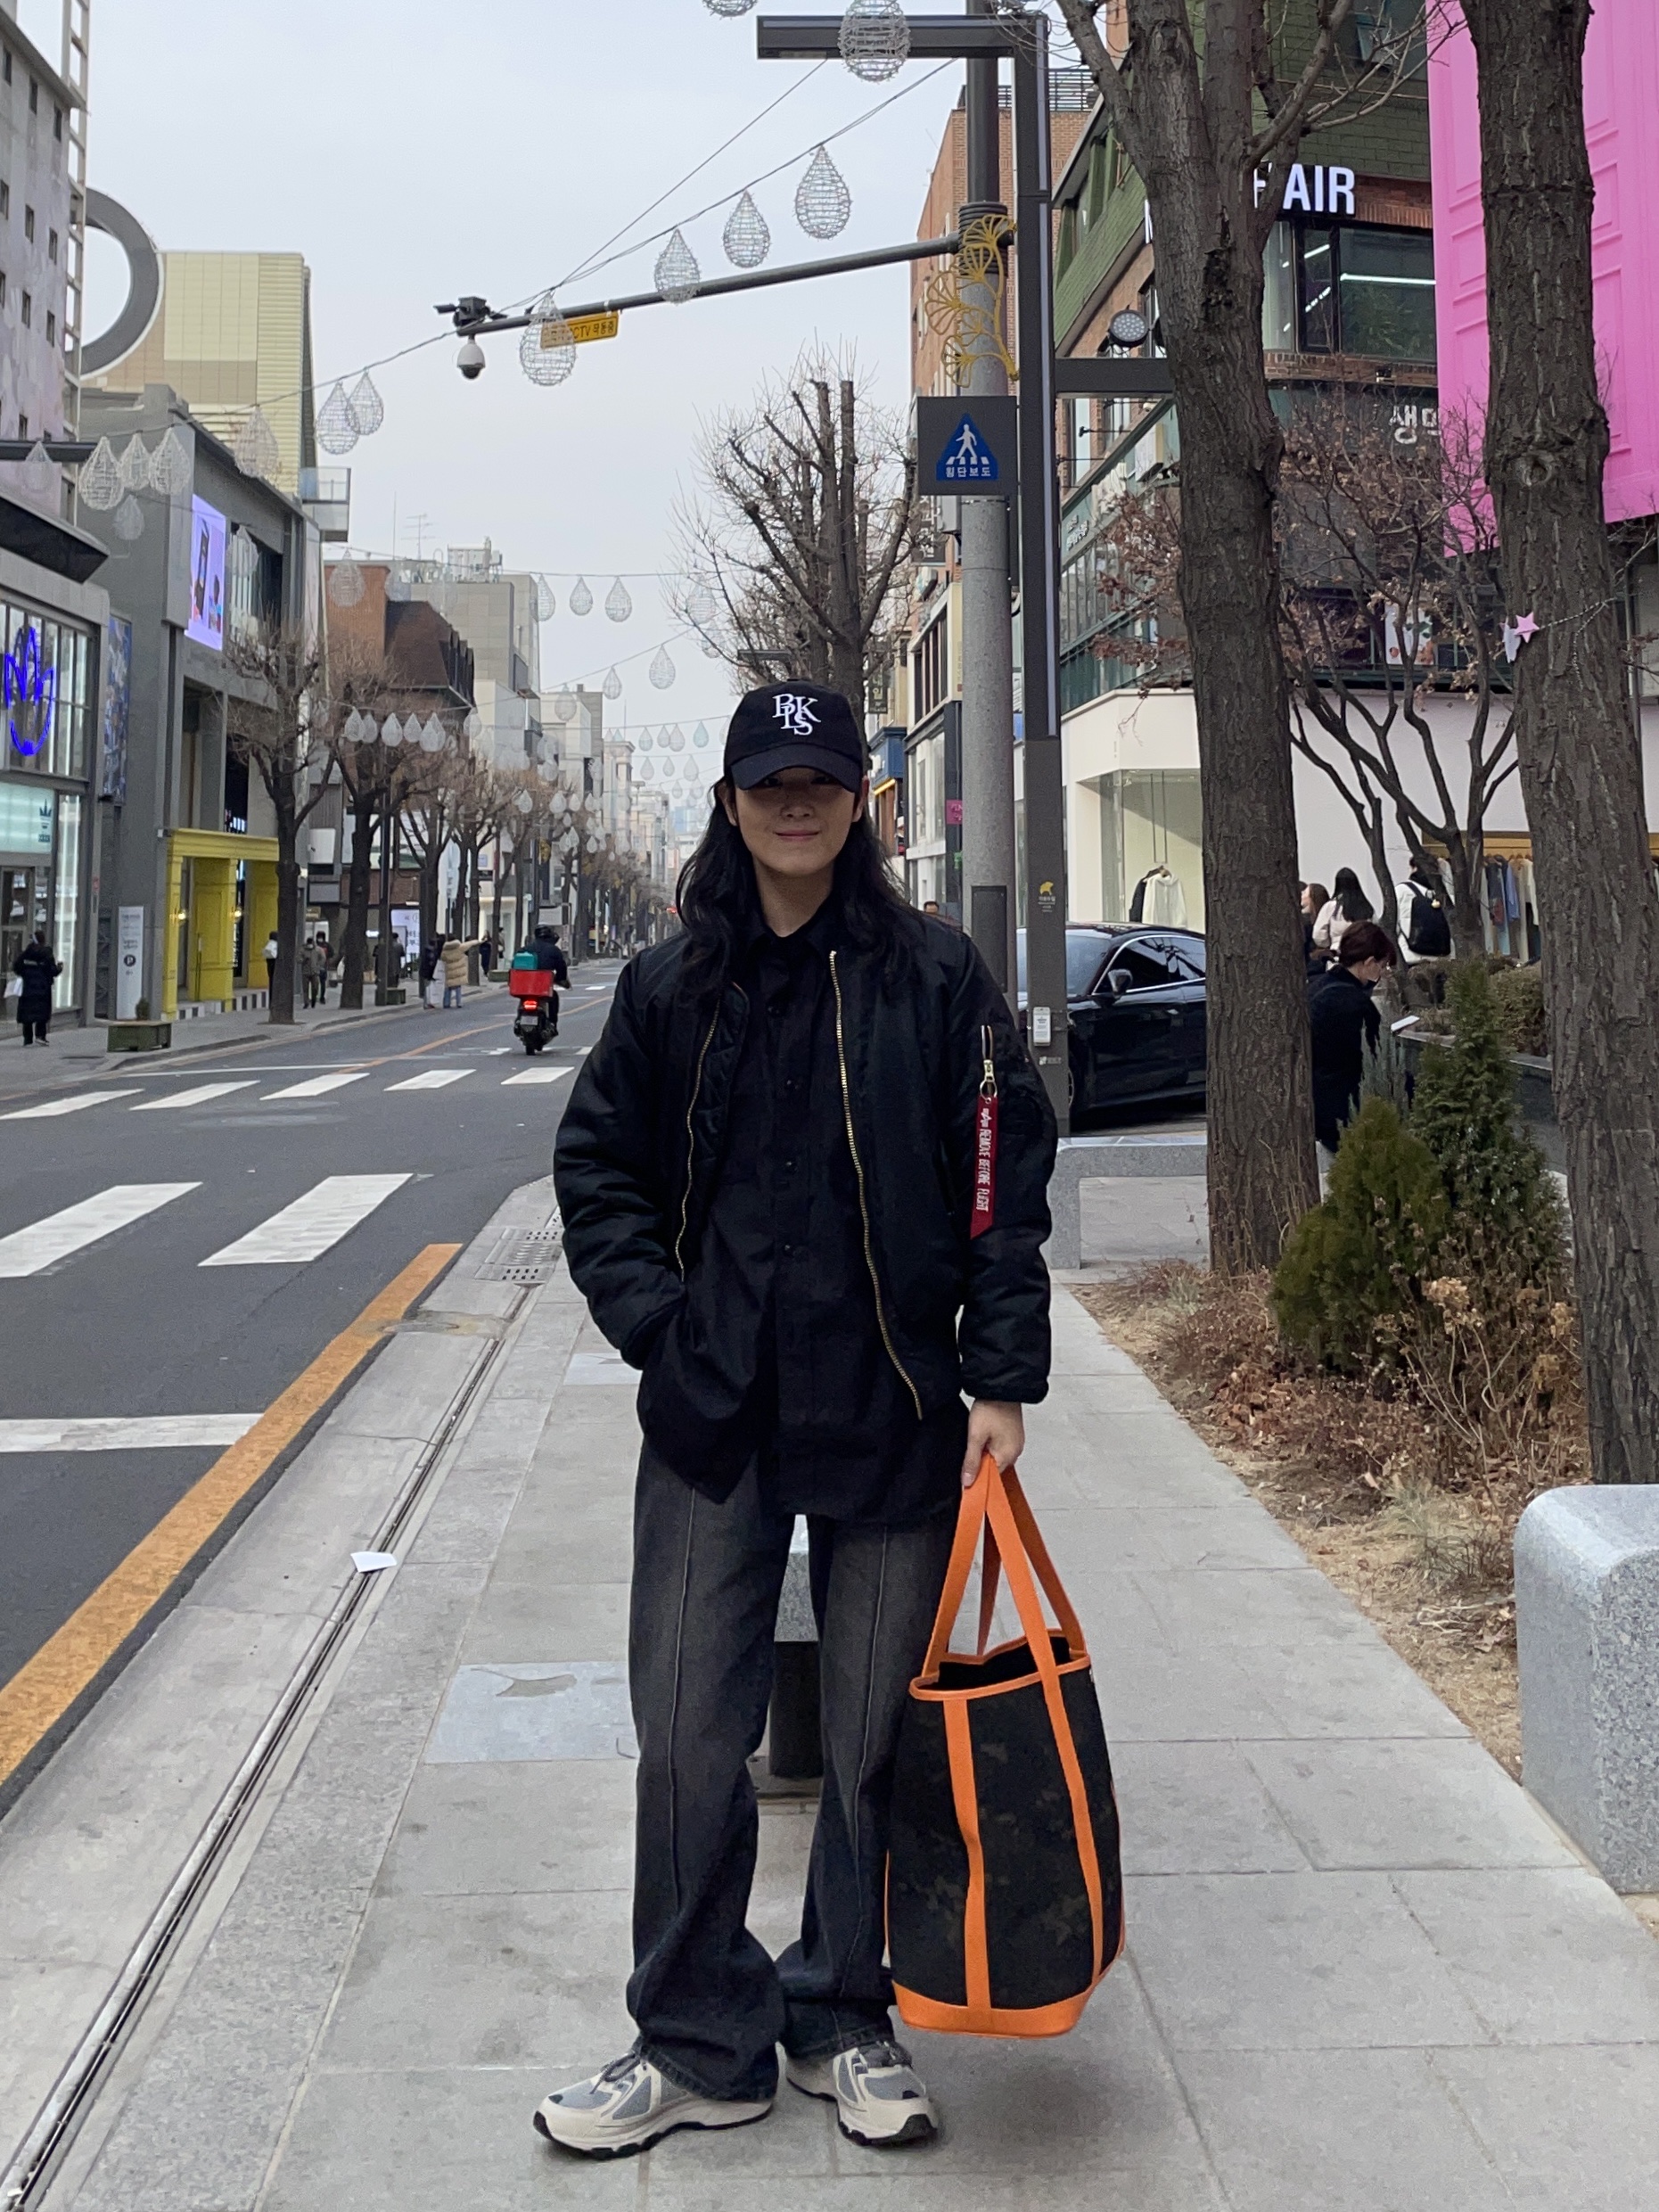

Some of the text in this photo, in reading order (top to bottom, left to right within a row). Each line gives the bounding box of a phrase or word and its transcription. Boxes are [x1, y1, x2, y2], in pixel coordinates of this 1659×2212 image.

[945, 466, 991, 478] 횡단보도
[975, 1128, 992, 1213] REMOVE BEFORE FLIGHT
